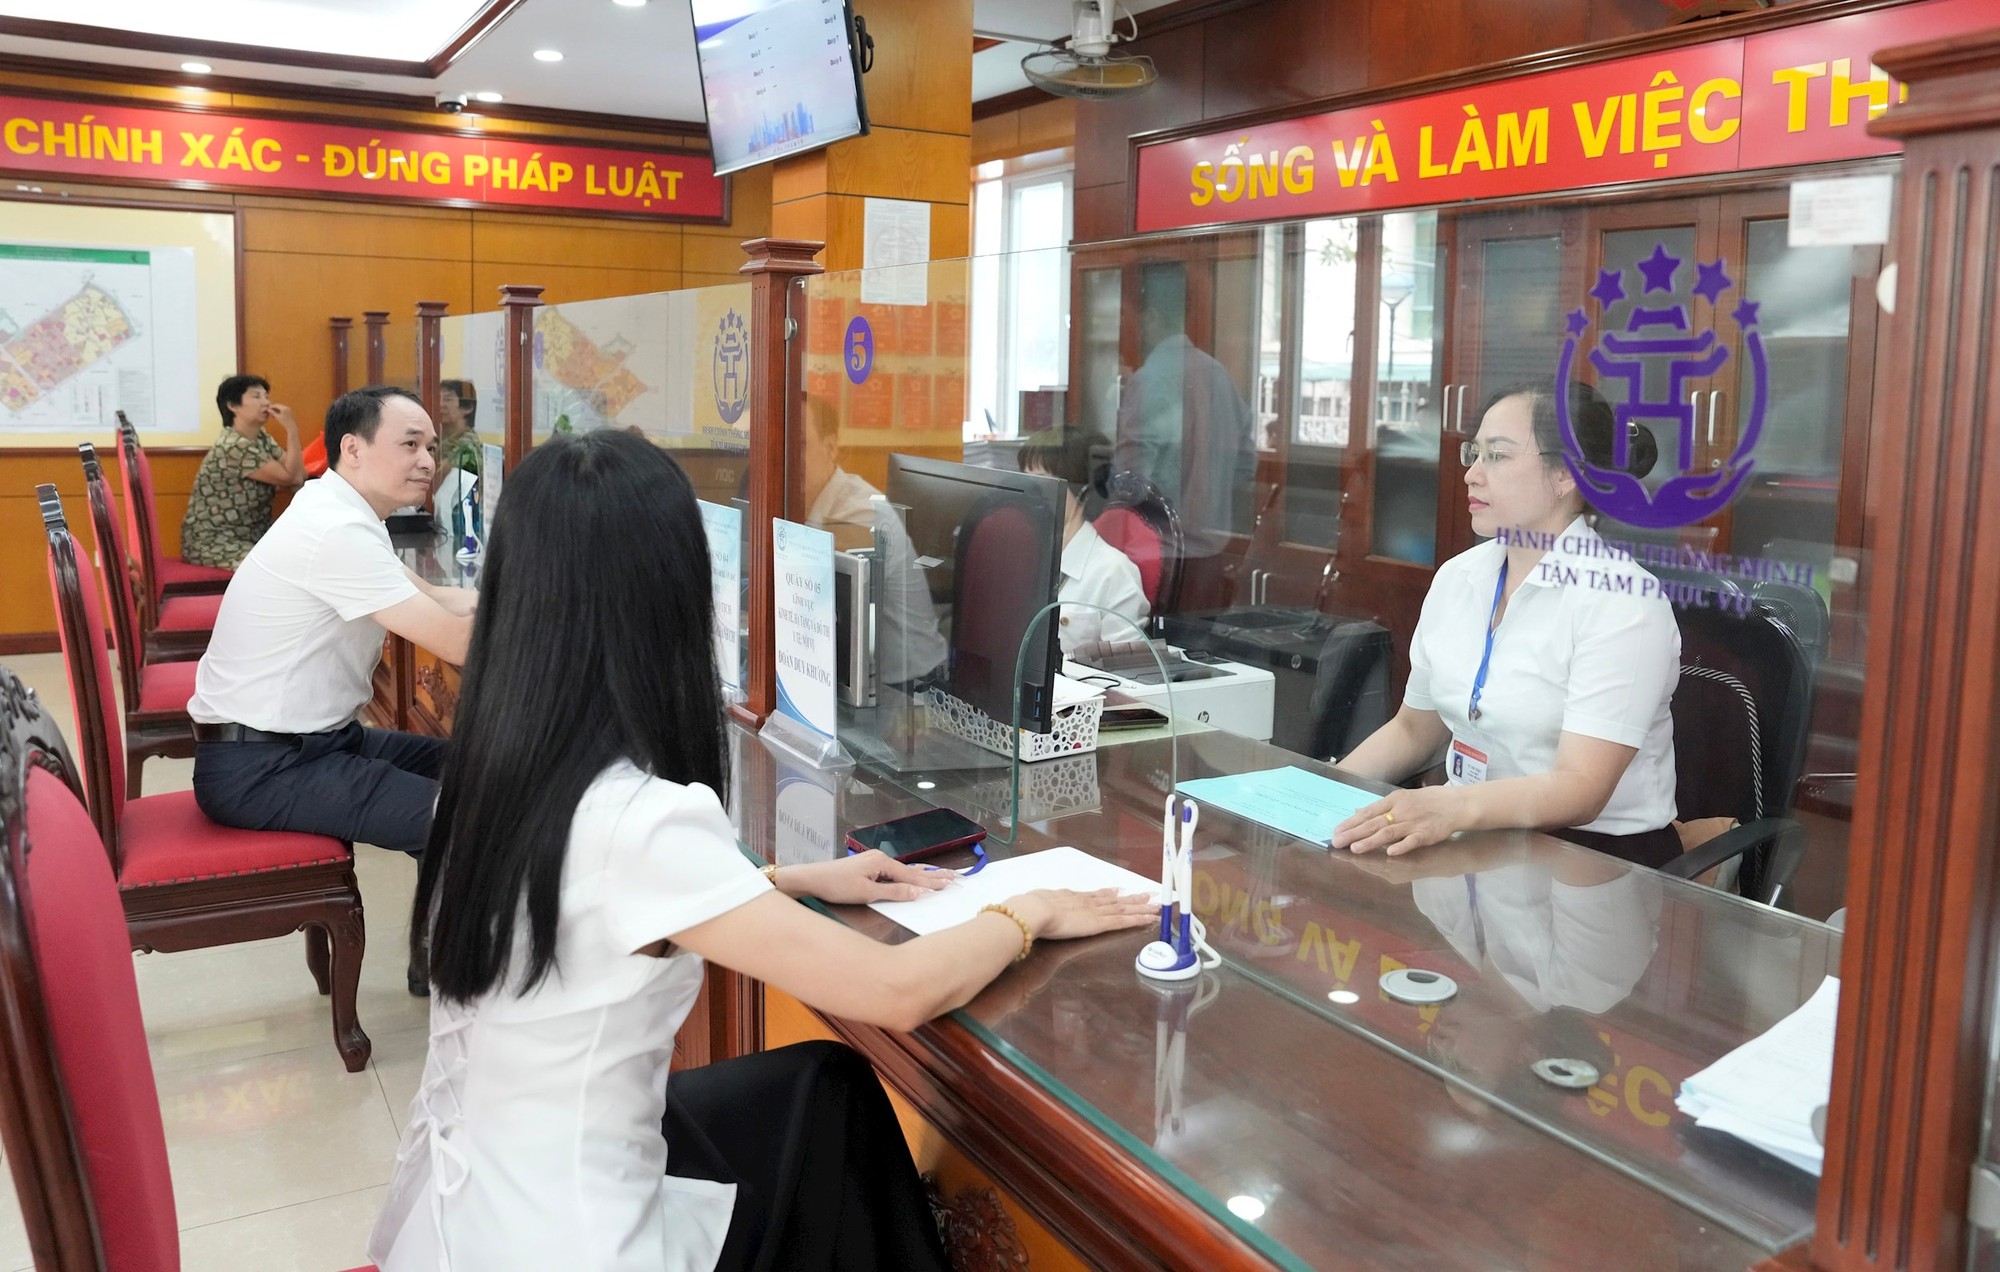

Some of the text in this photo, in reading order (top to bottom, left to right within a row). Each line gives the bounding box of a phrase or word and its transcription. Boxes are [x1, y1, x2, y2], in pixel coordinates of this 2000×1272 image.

[4, 115, 684, 207] CHÍNH XÁC - ĐÚNG PHÁP LUẬT
[1189, 136, 1314, 207] SỐNG
[1331, 119, 1400, 188] VÀ
[1418, 103, 1550, 179] LÀM
[1571, 70, 1743, 169] VIỆC
[850, 331, 867, 371] 5
[1496, 524, 1555, 552] HÀNH
[1738, 556, 1815, 588] MINH
